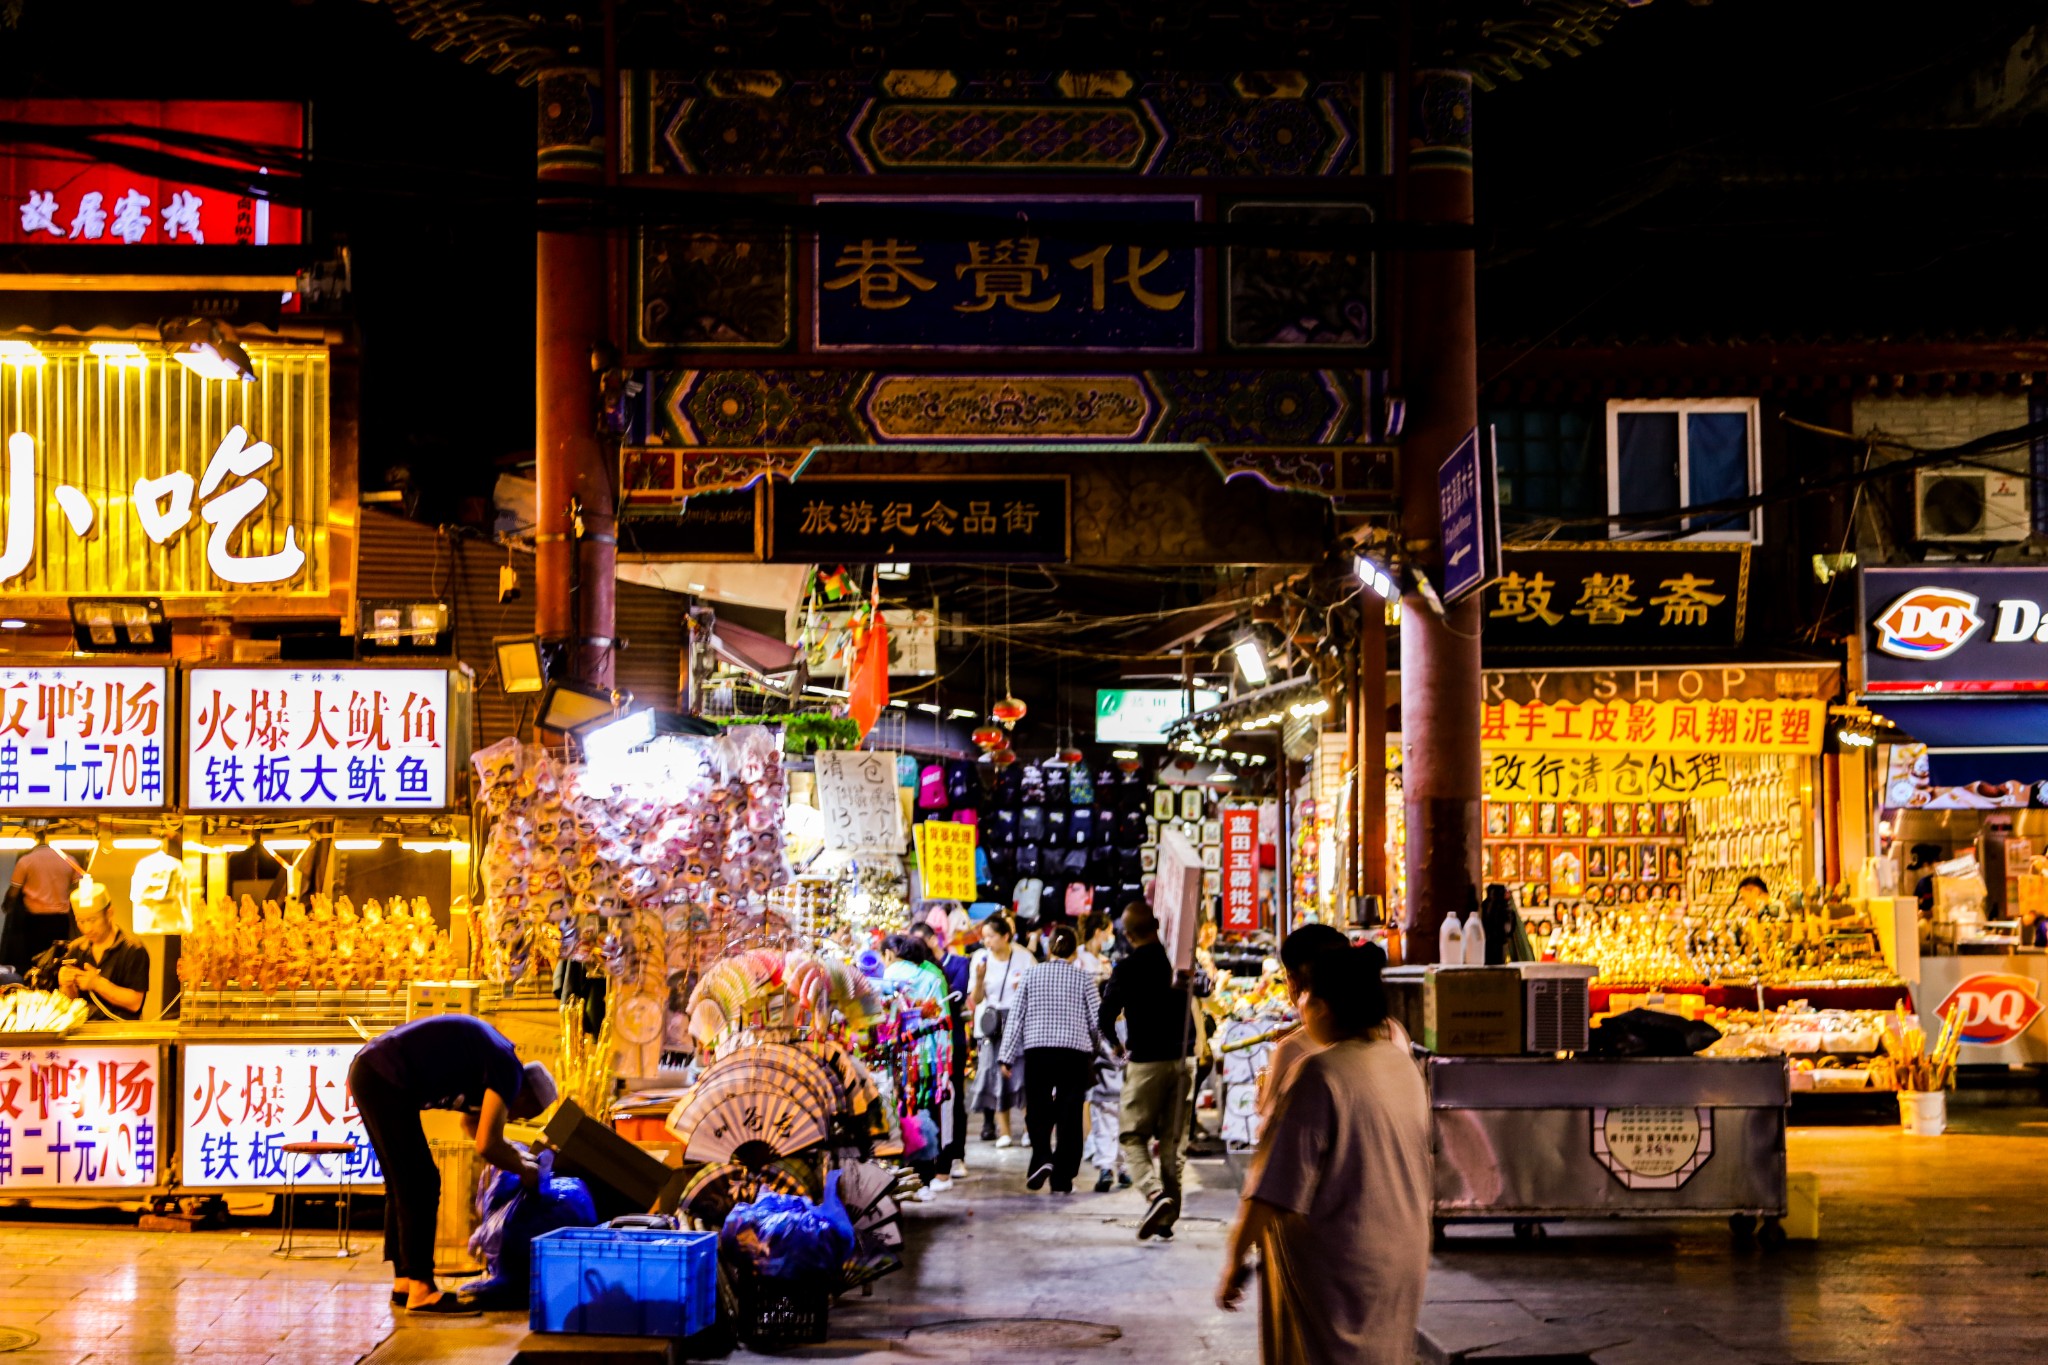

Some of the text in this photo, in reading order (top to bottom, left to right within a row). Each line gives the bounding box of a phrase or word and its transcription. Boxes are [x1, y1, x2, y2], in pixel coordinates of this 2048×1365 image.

[20, 189, 205, 245] 故居客栈
[0, 424, 306, 583] 小吃
[800, 499, 1040, 537] 旅游纪念品街
[1900, 604, 1965, 643] DQ
[1593, 668, 1747, 699] SHOP
[194, 689, 441, 752] 火爆大鱿鱼
[1669, 704, 1810, 745] 凤翔泥塑
[205, 753, 432, 803] 铁板大鱿鱼
[1491, 752, 1727, 799] 改行清仓处理
[1230, 815, 1253, 925] 蓝田玉器批发
[1956, 989, 2025, 1031] DQ
